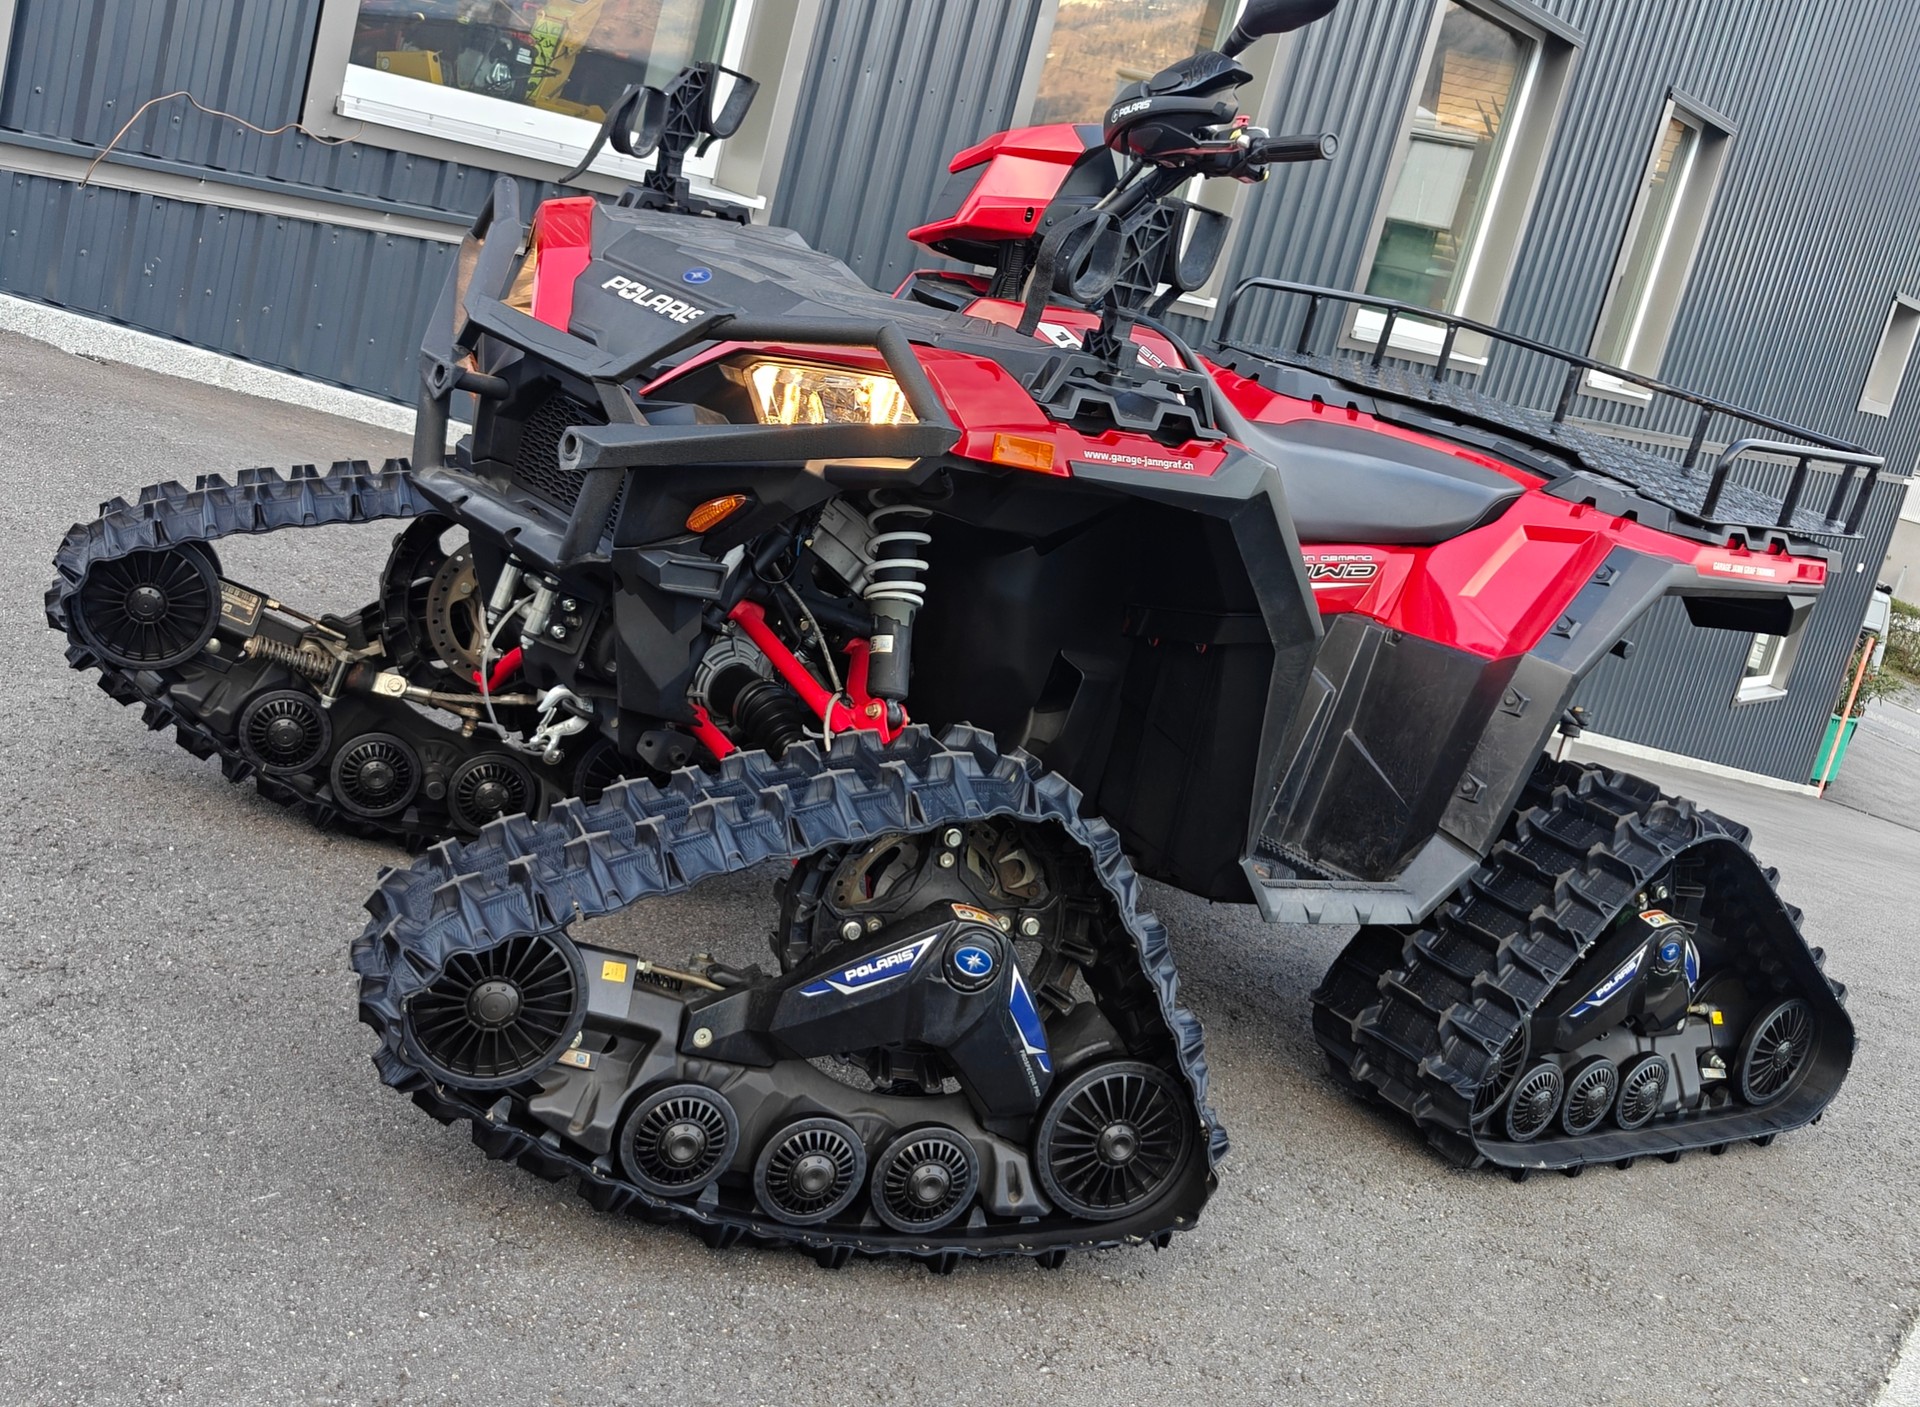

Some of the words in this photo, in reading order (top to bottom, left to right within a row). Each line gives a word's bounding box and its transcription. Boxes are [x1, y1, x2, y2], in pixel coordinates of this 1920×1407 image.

[1118, 99, 1152, 117] POLARIS
[601, 275, 705, 324] POLARIS
[1083, 450, 1194, 470] www.garage-janngraf.ch
[844, 949, 914, 982] POLARIS
[1595, 961, 1637, 998] POLARIS
[1019, 1049, 1038, 1086] PROSPECTOR
